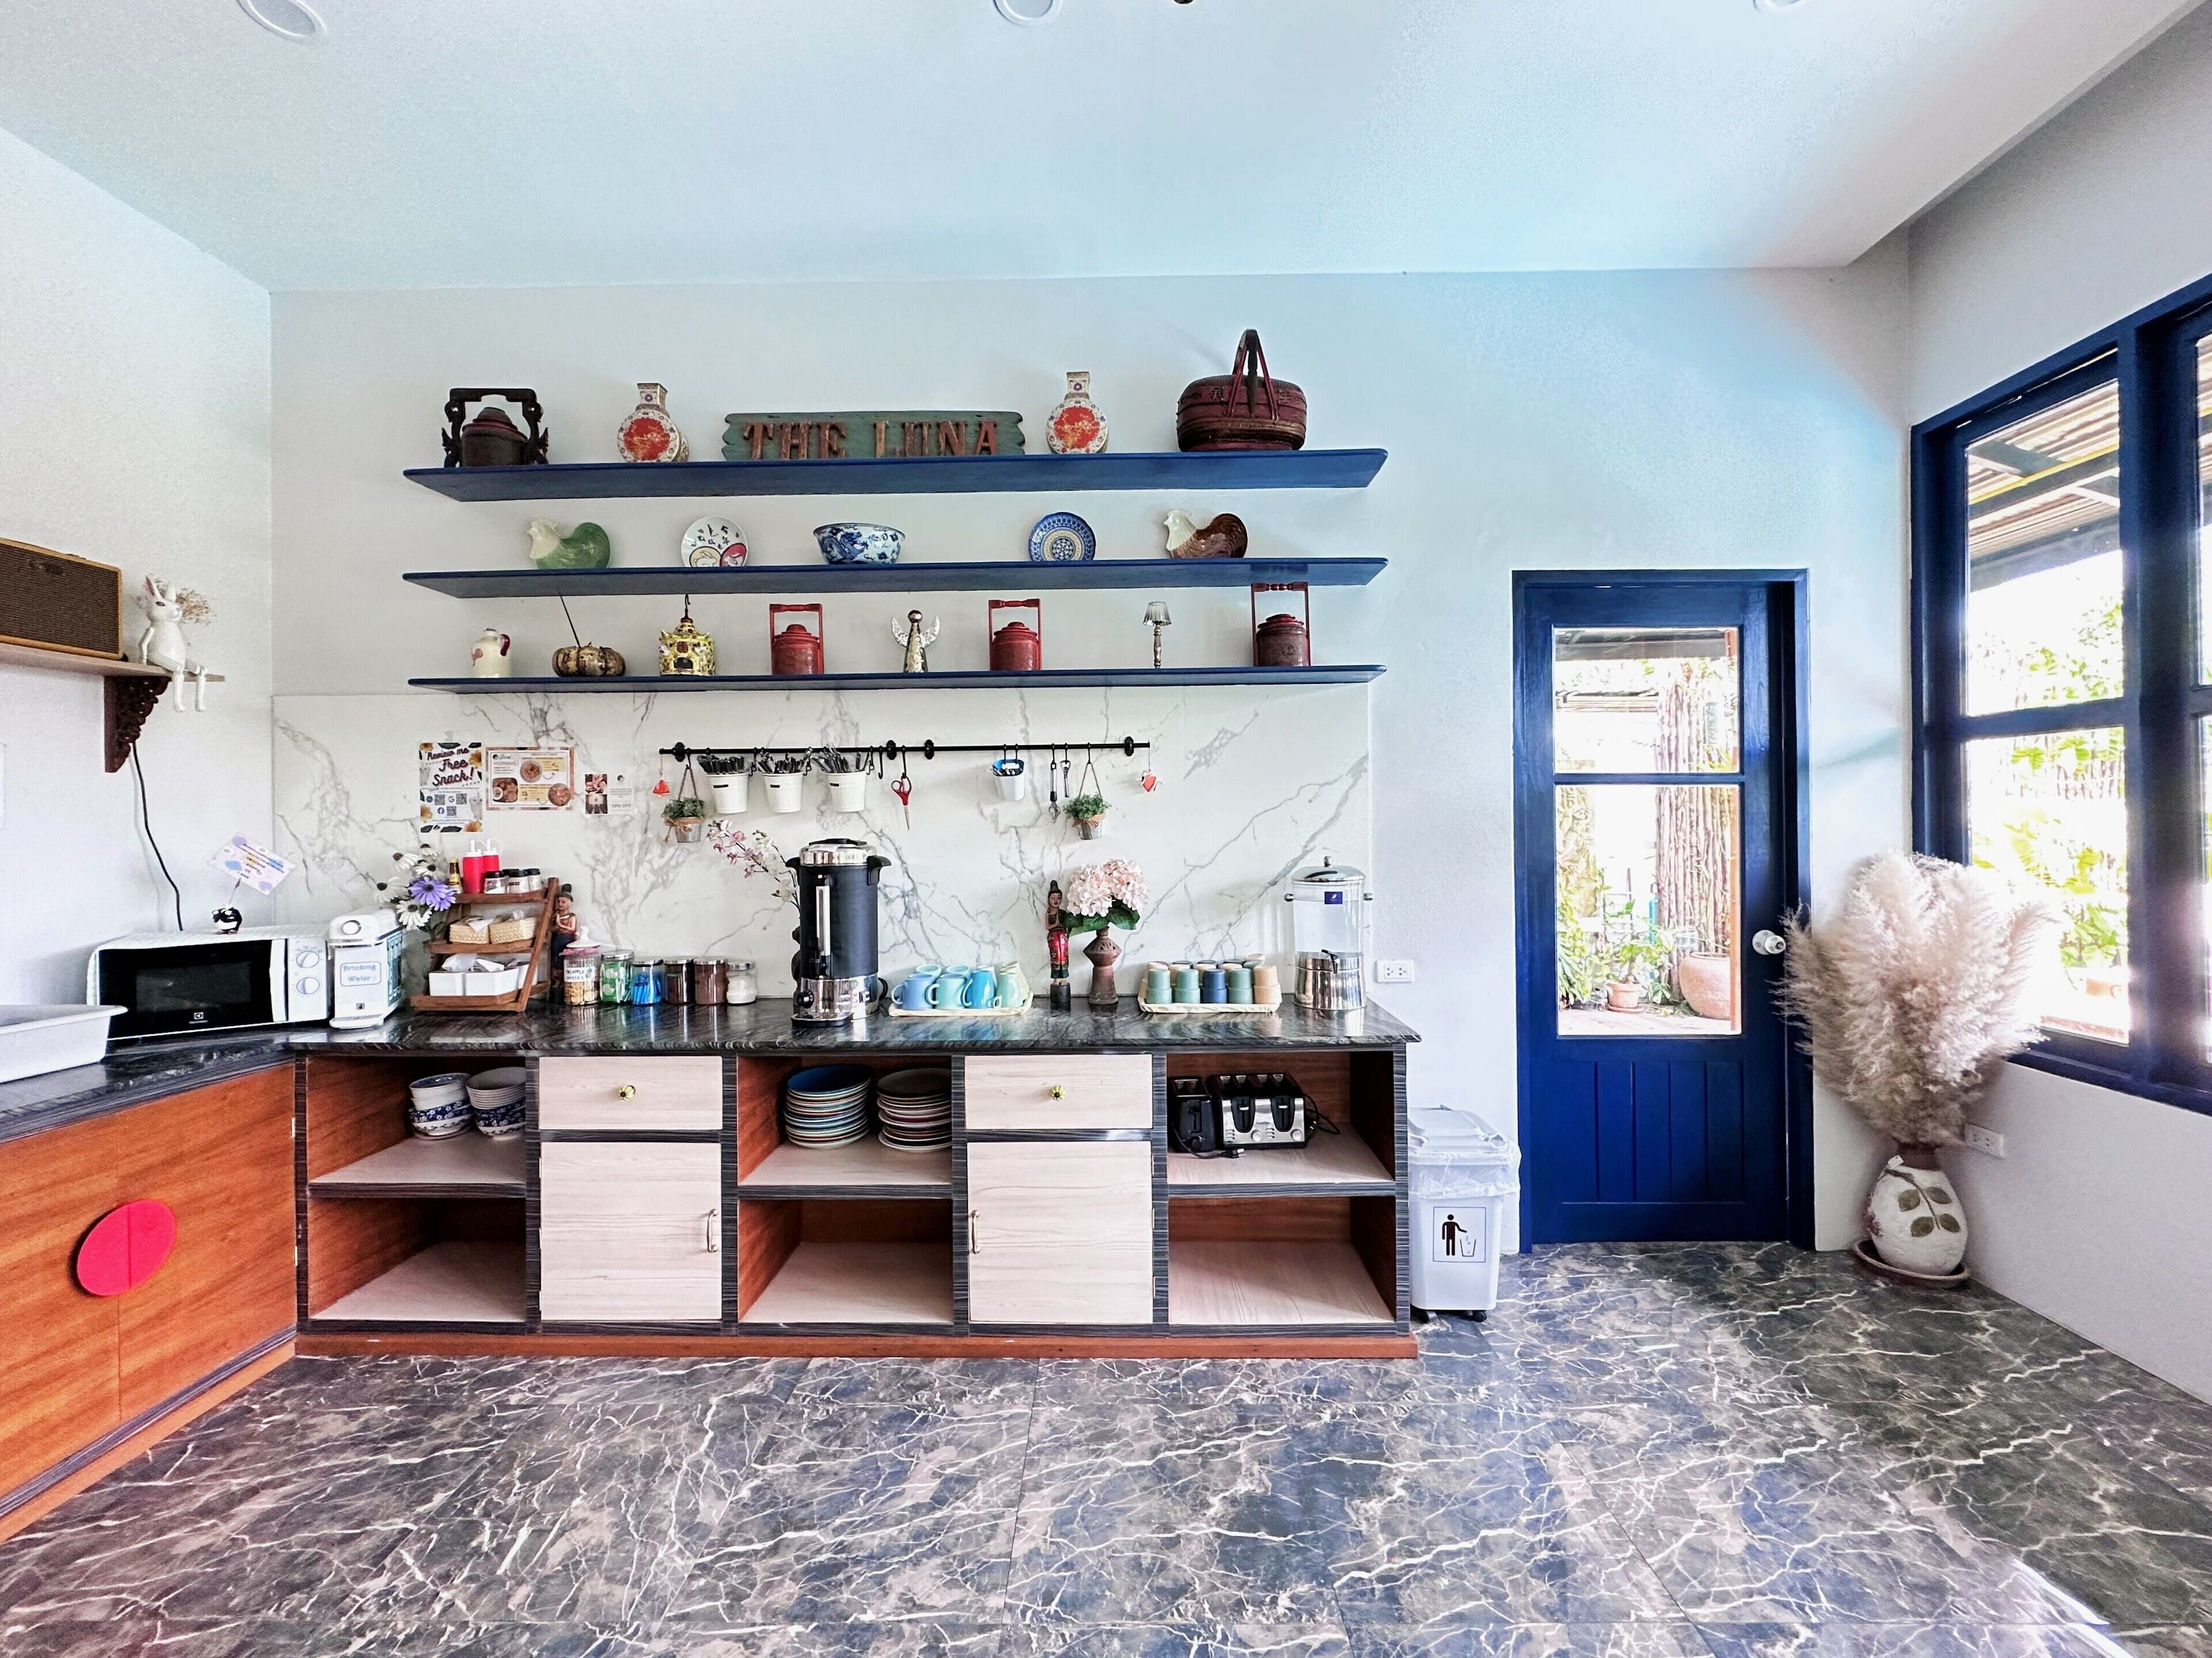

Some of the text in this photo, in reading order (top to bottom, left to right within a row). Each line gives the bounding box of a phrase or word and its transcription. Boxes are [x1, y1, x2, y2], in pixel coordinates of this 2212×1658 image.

[743, 420, 999, 460] THE LUNA
[427, 750, 455, 761] Review
[439, 758, 468, 772] Free
[433, 767, 474, 786] Snack!
